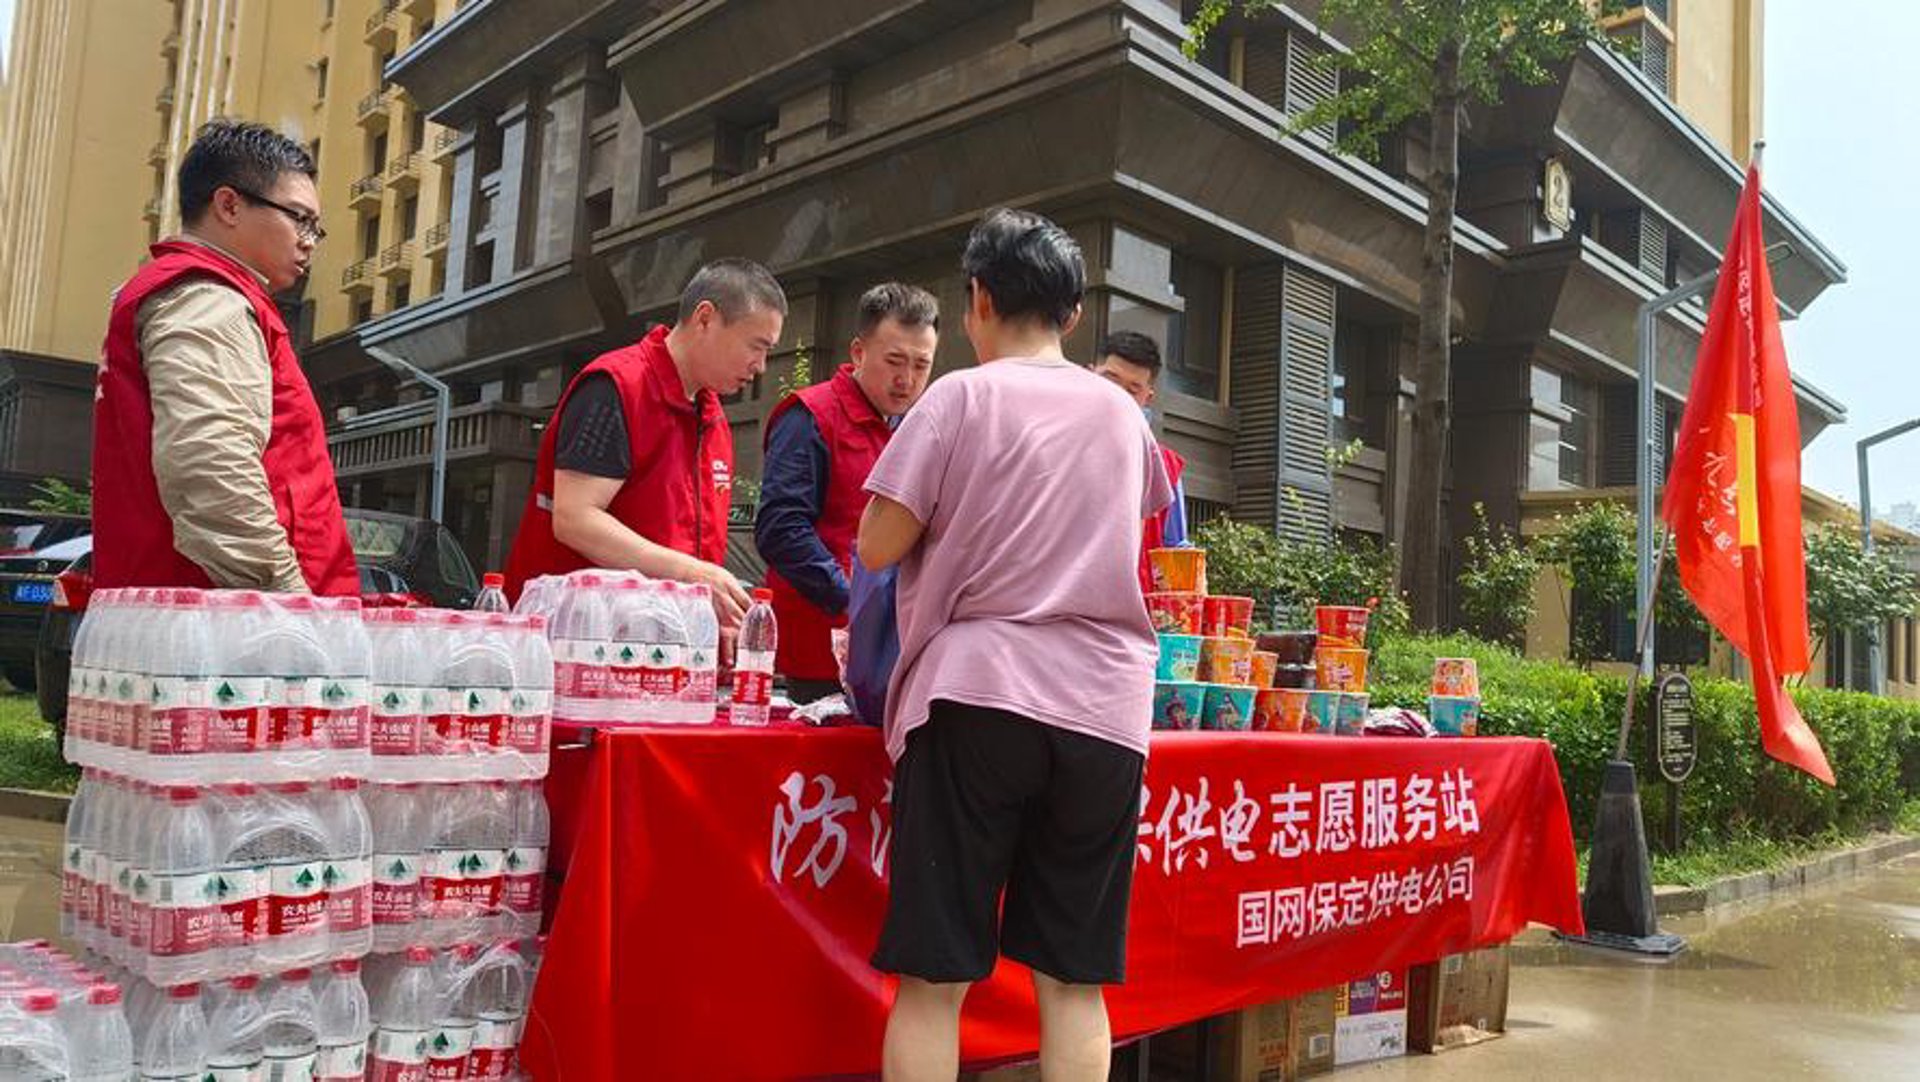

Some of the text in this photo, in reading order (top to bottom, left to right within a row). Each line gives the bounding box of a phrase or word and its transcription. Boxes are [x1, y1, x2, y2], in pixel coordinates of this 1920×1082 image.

[1553, 175, 1566, 208] 2
[1237, 856, 1475, 949] 国网保定供电公司
